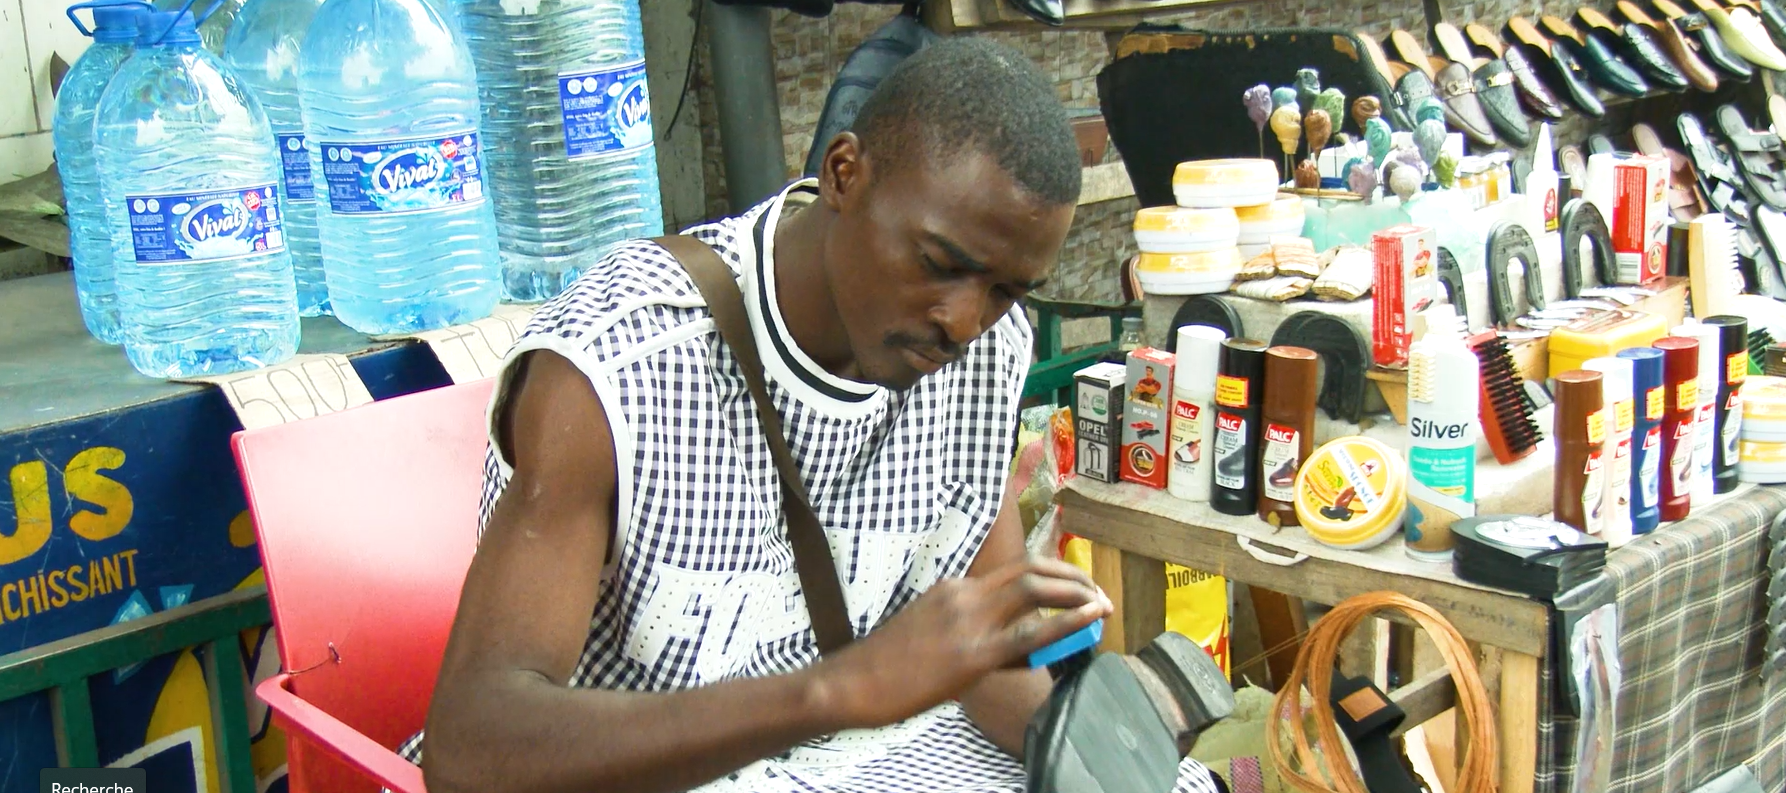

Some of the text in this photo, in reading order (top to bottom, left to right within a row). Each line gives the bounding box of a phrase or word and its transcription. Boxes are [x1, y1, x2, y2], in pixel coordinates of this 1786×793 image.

[1177, 405, 1195, 418] PALC
[1079, 420, 1107, 436] OPEL
[1219, 417, 1237, 430] PALC
[1410, 417, 1469, 439] Silver
[1269, 429, 1290, 442] PALC
[0, 549, 138, 625] CHISSANT
